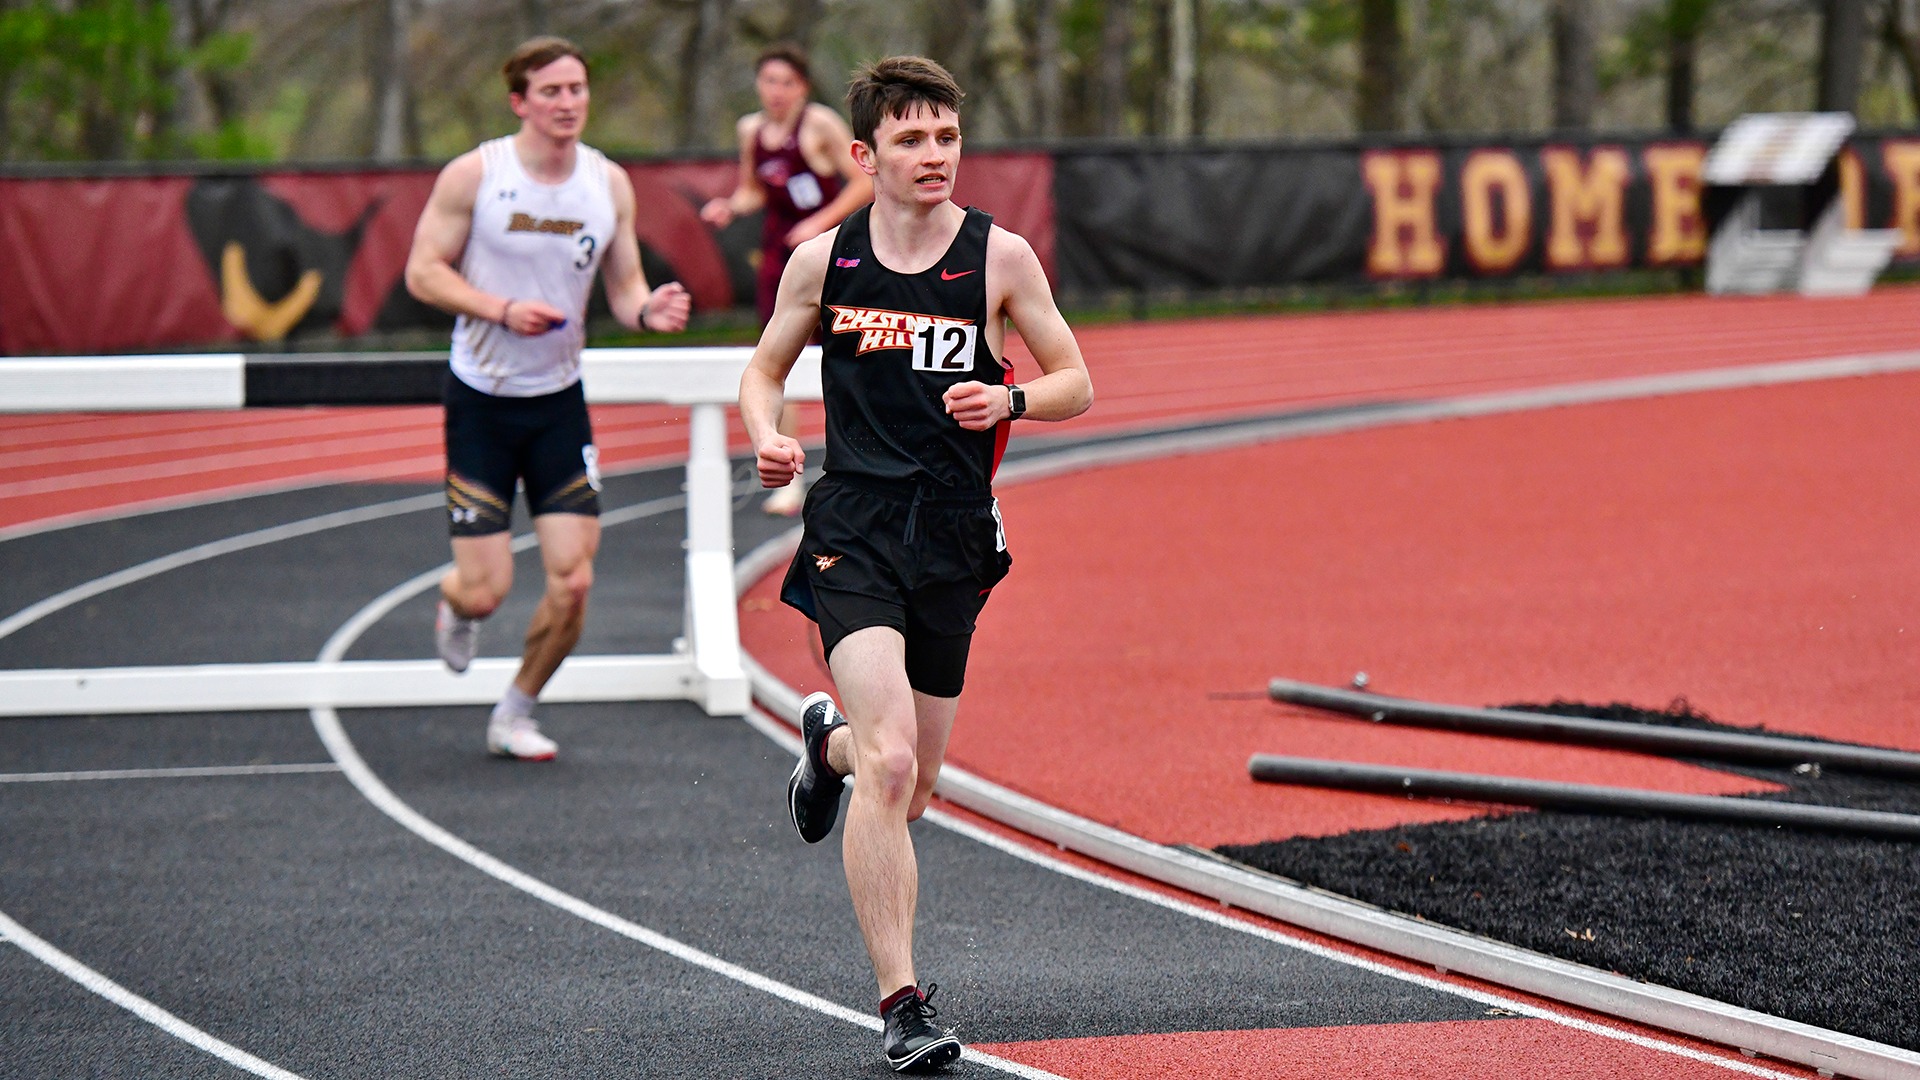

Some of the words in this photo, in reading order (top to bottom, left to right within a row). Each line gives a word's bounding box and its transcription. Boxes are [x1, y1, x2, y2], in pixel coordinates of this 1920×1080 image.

[1363, 141, 1704, 278] HOME
[575, 235, 596, 270] 3
[830, 304, 972, 334] CHESTN
[857, 329, 914, 356] HIL
[917, 325, 968, 370] 12
